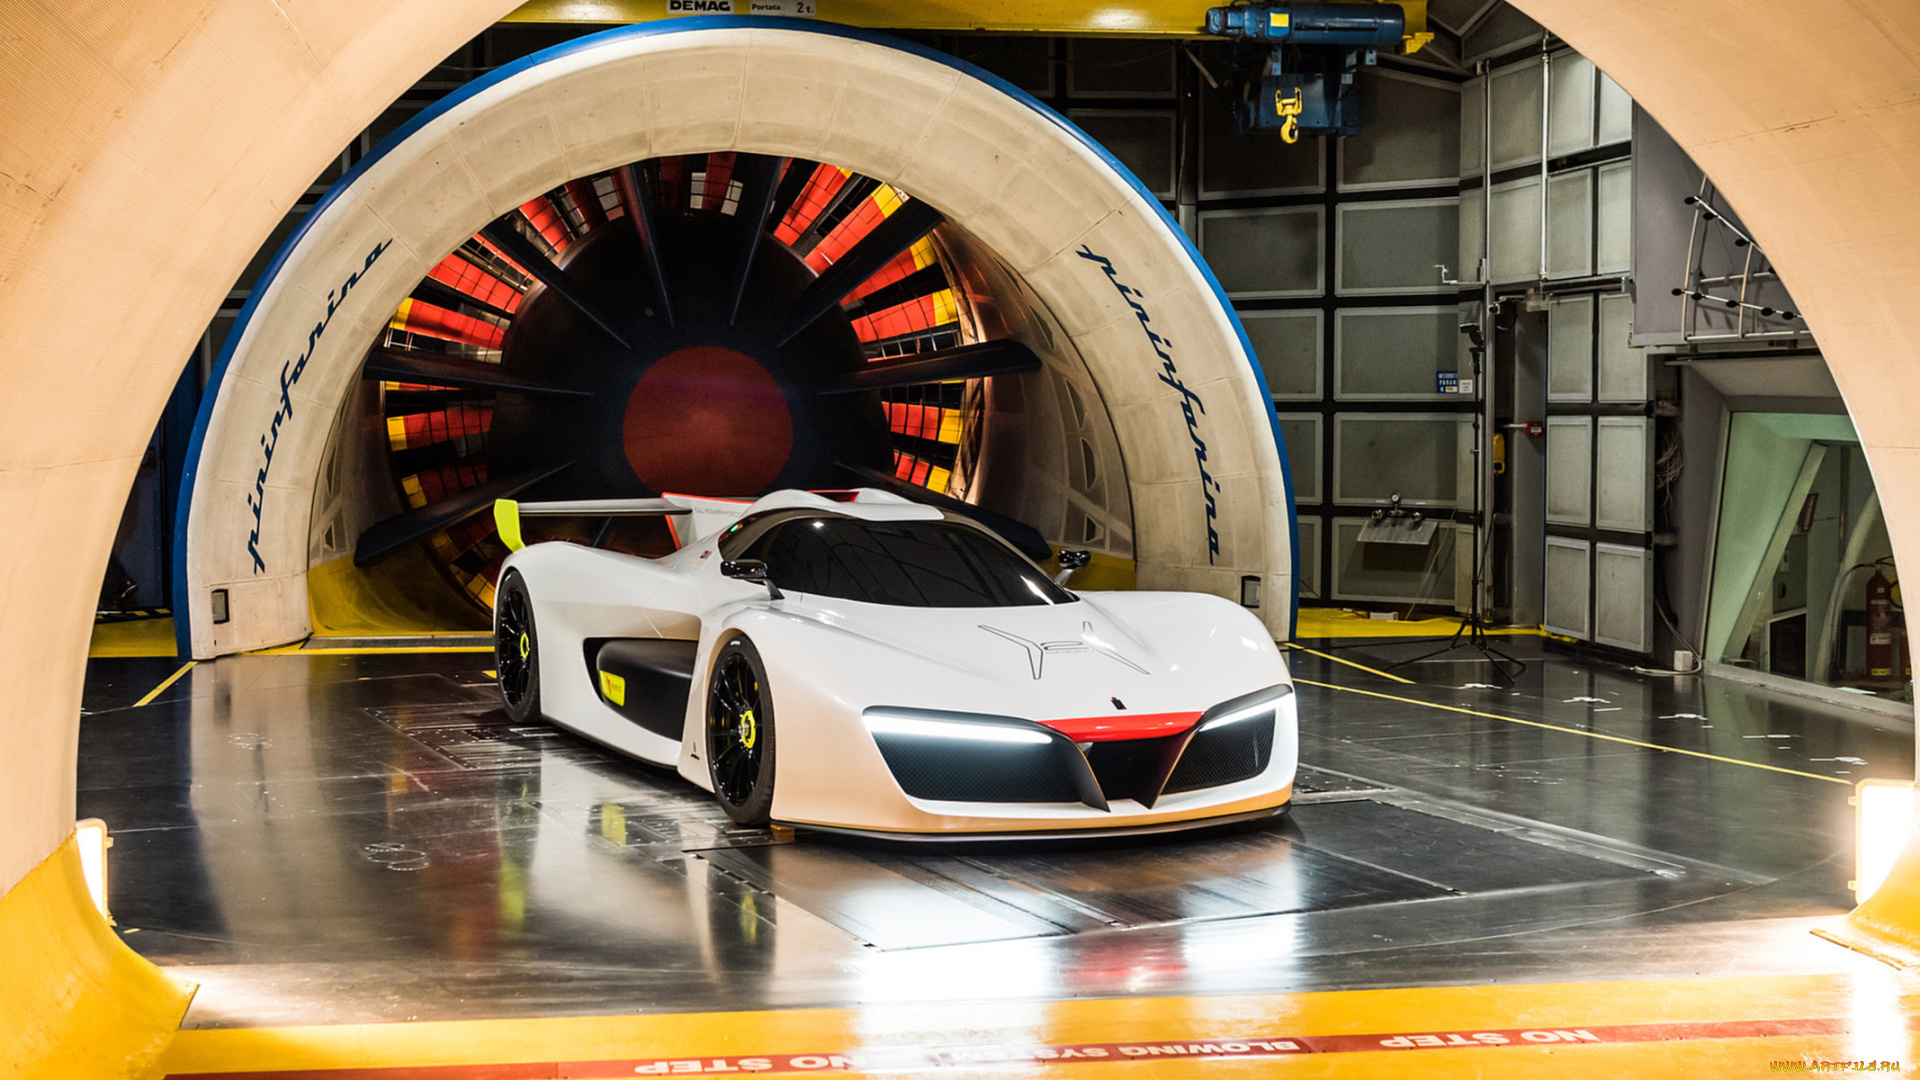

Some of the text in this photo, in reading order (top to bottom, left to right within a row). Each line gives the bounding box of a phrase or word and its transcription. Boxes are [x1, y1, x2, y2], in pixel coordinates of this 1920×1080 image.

[669, 0, 731, 11] DEMAG
[751, 3, 781, 11] Portata
[796, 2, 804, 13] 2
[248, 238, 393, 575] pininfarina
[1075, 244, 1221, 566] pininfarina
[1117, 1040, 1300, 1056] BLOWING
[1379, 1029, 1600, 1048] NO STEP
[634, 1055, 868, 1074] NO STEP
